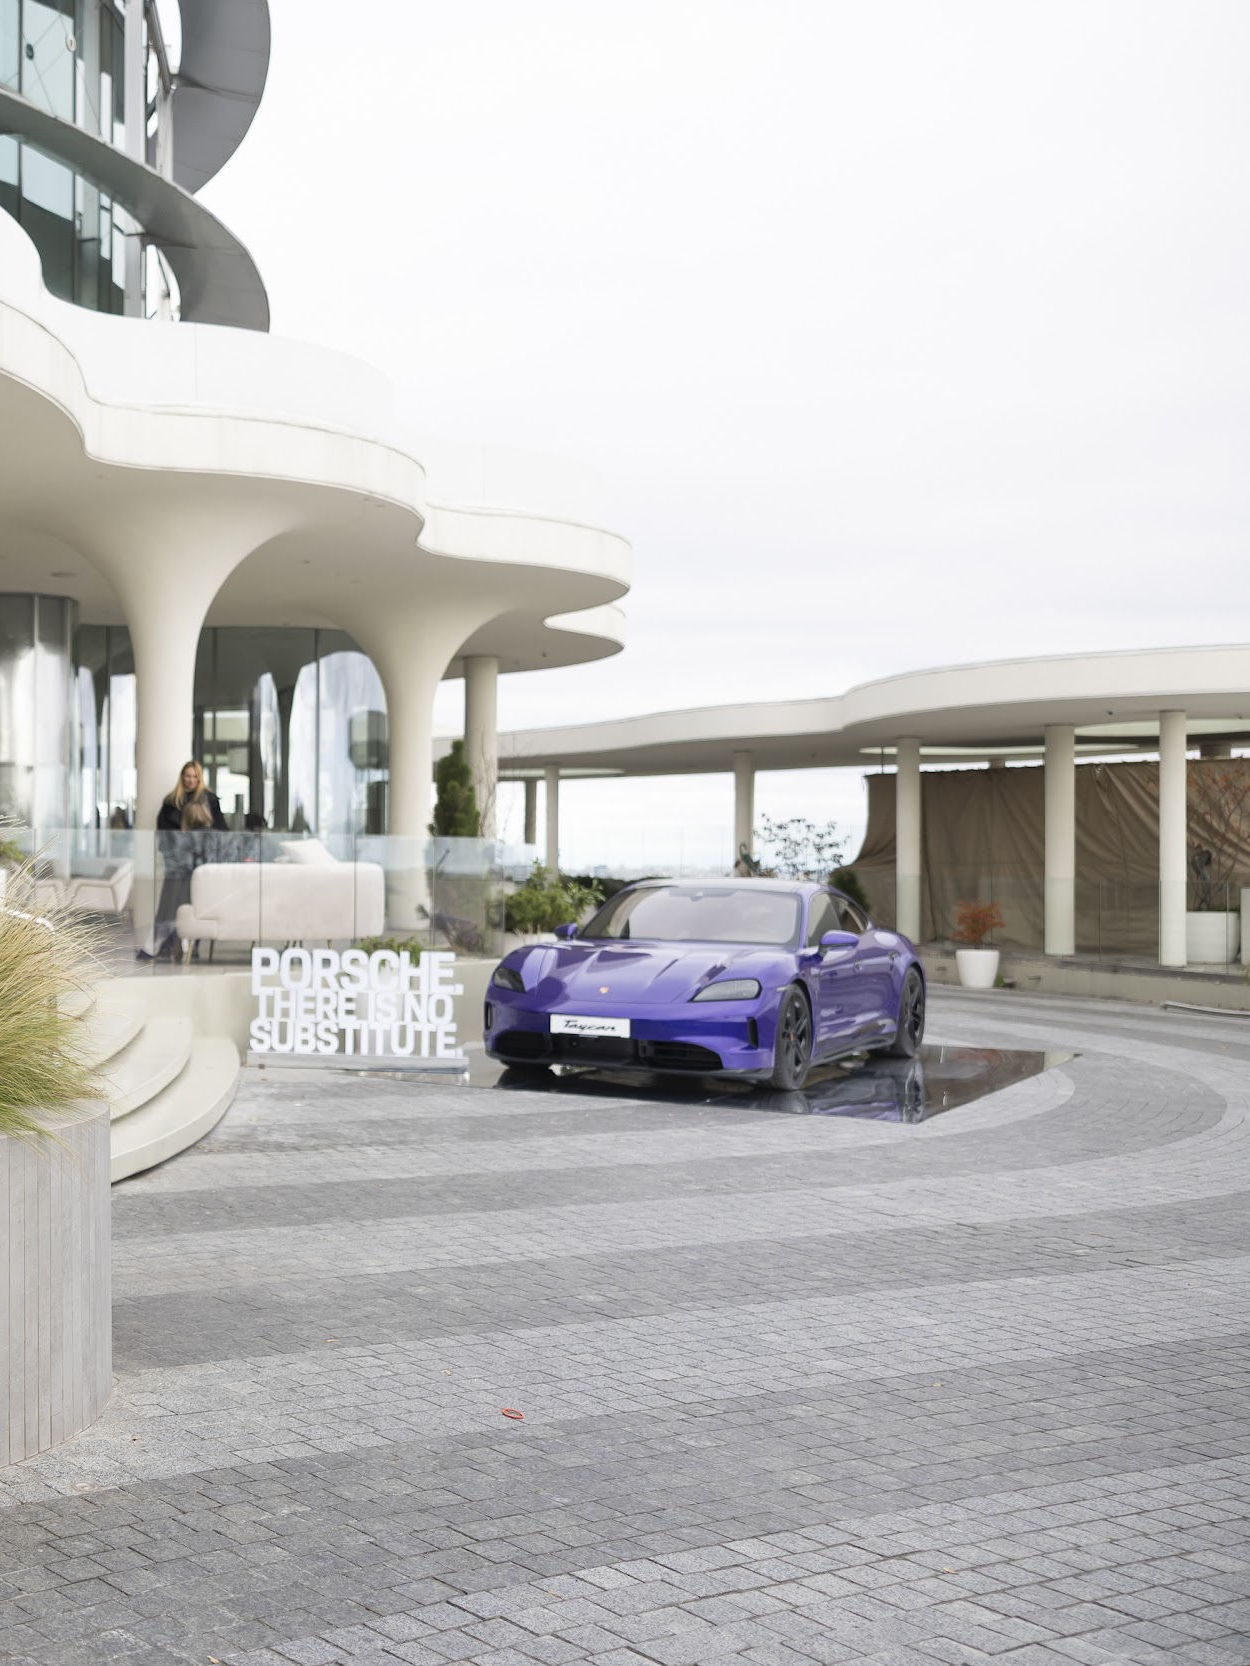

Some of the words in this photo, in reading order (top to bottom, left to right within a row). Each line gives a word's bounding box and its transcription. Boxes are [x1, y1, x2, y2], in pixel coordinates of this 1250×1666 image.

[251, 947, 464, 996] PORSCHE.
[258, 989, 357, 1024] THERE
[367, 991, 398, 1024] IS
[403, 993, 454, 1026] NO
[564, 1019, 616, 1032] Taycan
[249, 1017, 463, 1057] SUBSTITUTE.
